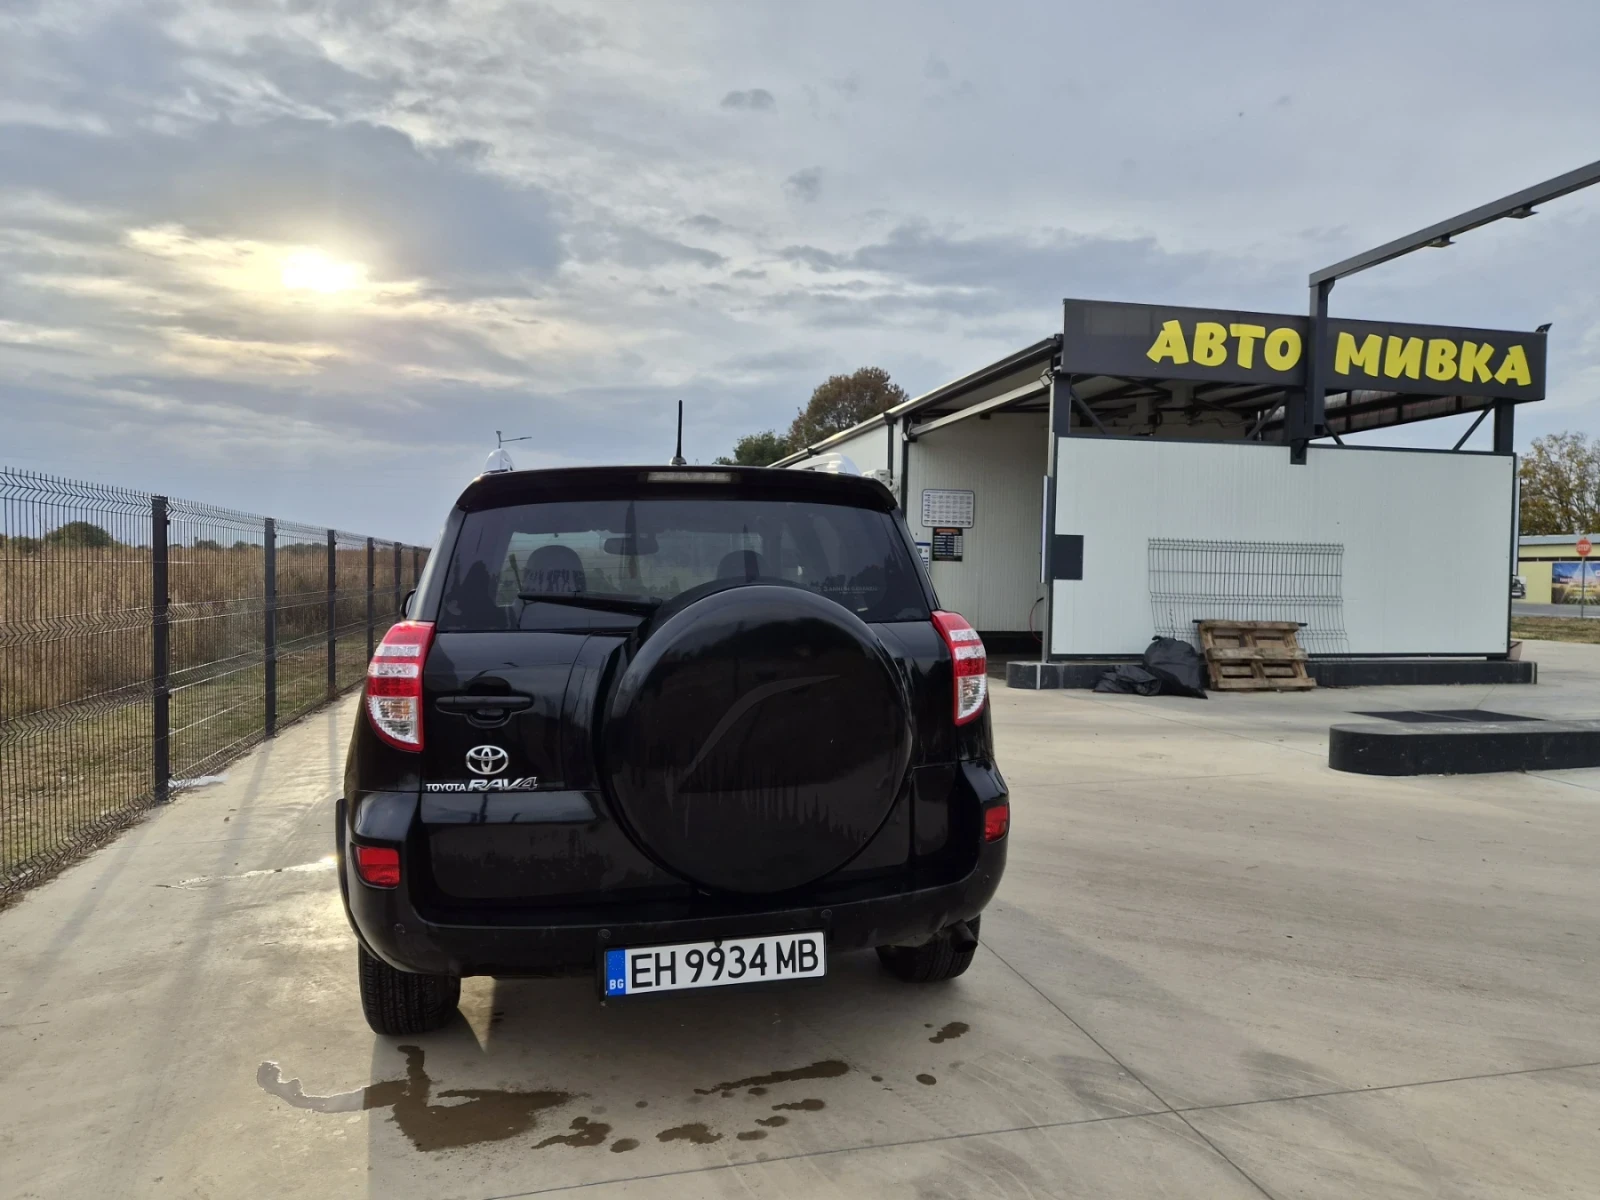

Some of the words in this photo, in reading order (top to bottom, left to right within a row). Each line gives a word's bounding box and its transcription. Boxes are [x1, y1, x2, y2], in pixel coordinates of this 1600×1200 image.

[1146, 319, 1302, 371] АВТО
[1334, 331, 1532, 387] МИВКА
[1577, 544, 1590, 552] STOP
[426, 783, 466, 792] TOYOTA
[467, 776, 538, 791] RAV4
[631, 951, 677, 989] EH
[685, 942, 767, 983] 9934
[776, 939, 819, 975] MB
[609, 979, 624, 990] BG
